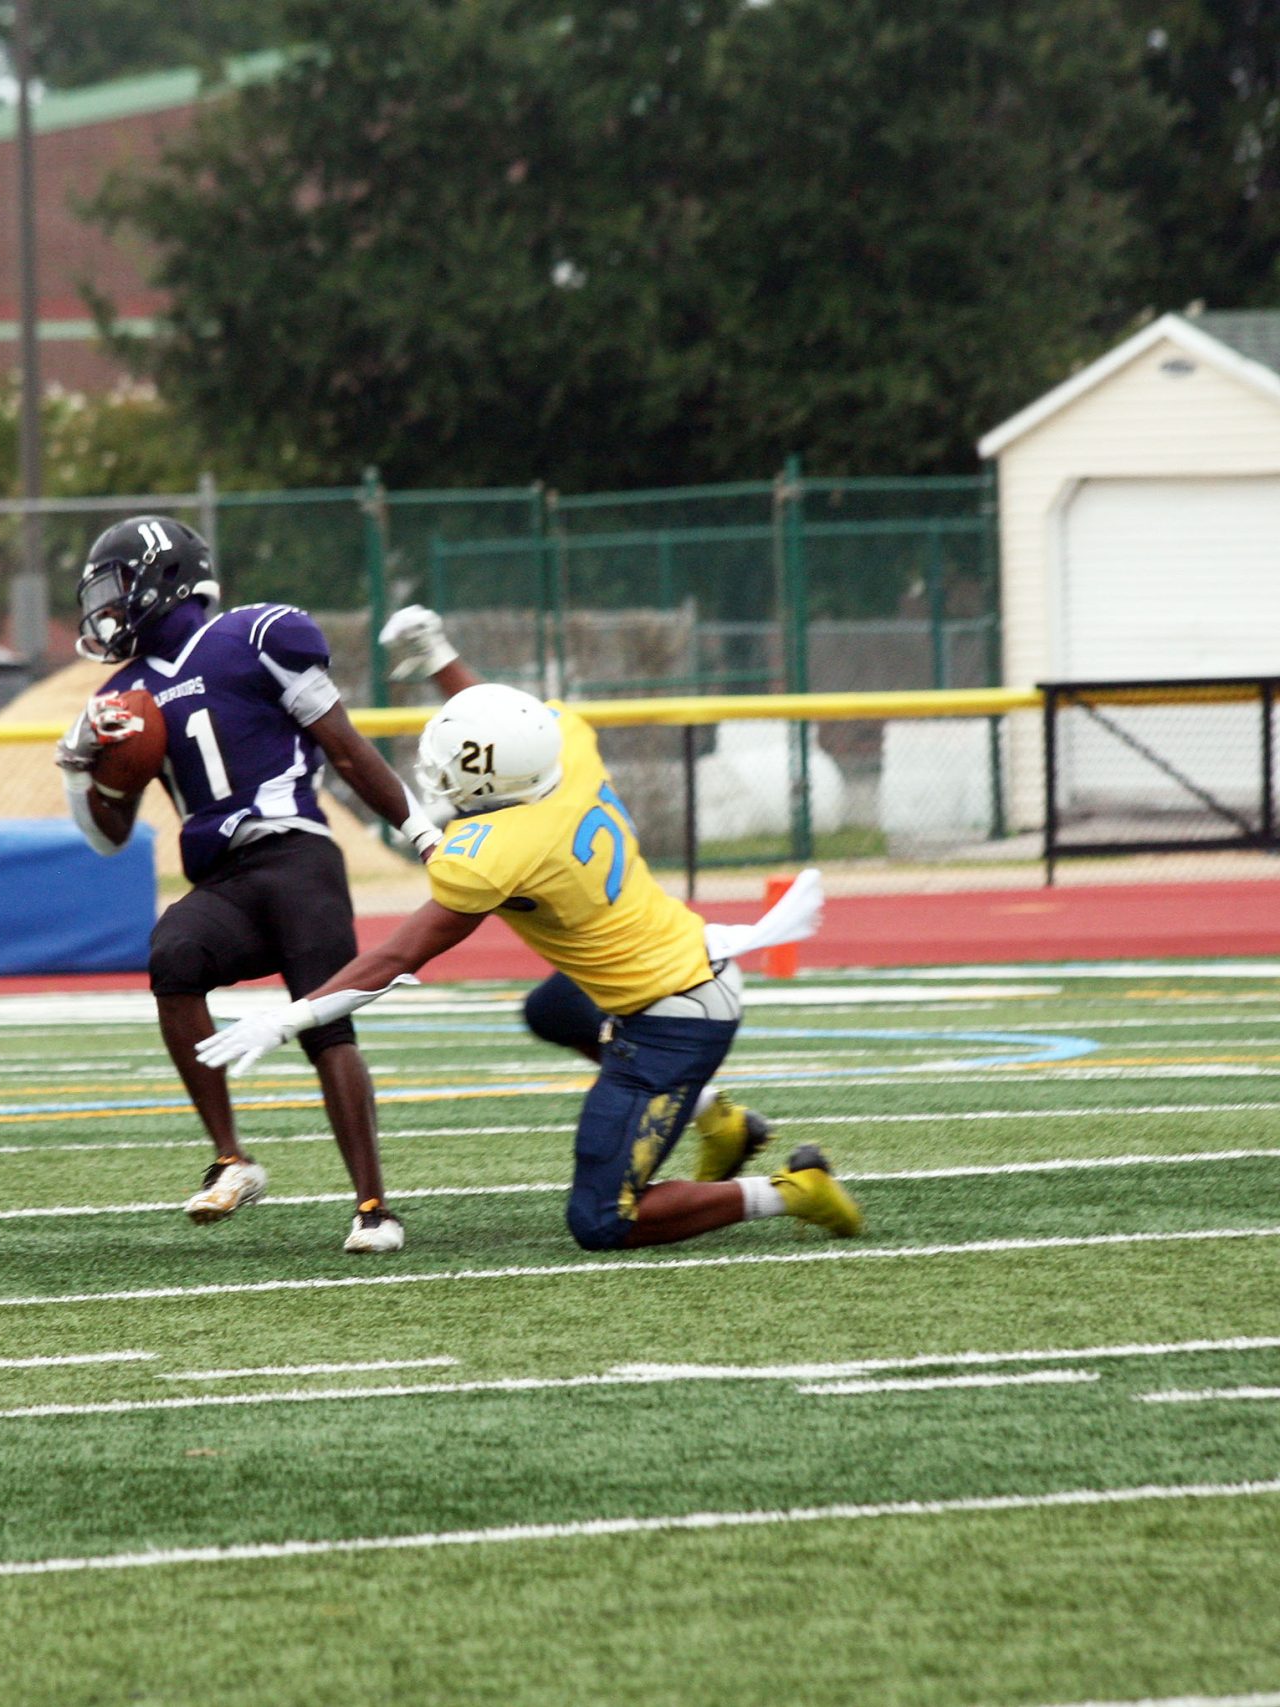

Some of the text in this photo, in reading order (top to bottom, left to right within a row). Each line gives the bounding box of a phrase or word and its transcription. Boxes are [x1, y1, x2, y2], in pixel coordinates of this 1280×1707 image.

[137, 521, 173, 551] 11
[461, 740, 496, 776] 21
[443, 822, 493, 859] 21
